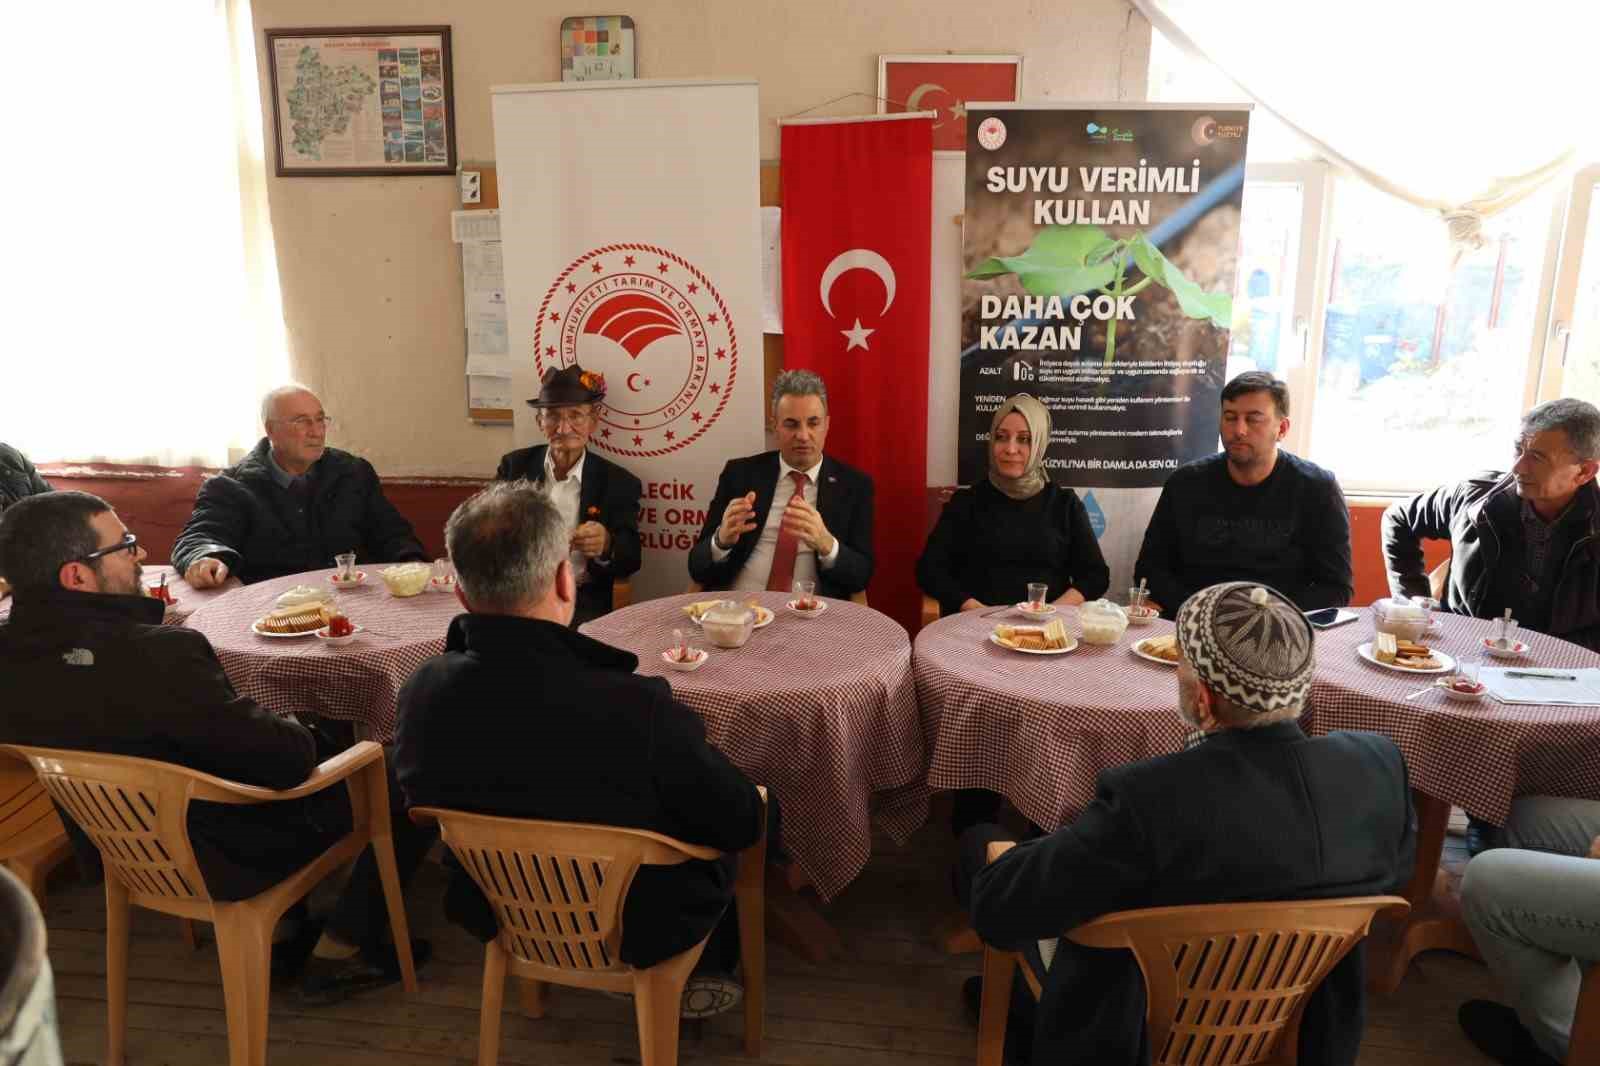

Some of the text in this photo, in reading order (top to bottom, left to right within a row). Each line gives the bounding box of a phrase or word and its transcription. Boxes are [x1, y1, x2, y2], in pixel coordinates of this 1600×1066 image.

[986, 158, 1200, 193] SUYU VERİMLİ
[1033, 199, 1150, 225] KULLAN
[613, 277, 655, 289] TARIM
[660, 286, 676, 299] VE
[677, 300, 705, 348] ORMAN
[981, 295, 1137, 327] DAHA ÇOK
[980, 326, 1082, 350] KAZAN
[979, 367, 1002, 375] AZALT
[975, 404, 1002, 412] KULLA
[1087, 456, 1102, 469] BİR
[1103, 458, 1135, 470] DAMLA
[1136, 458, 1148, 469] DA
[1148, 458, 1164, 469] SEN
